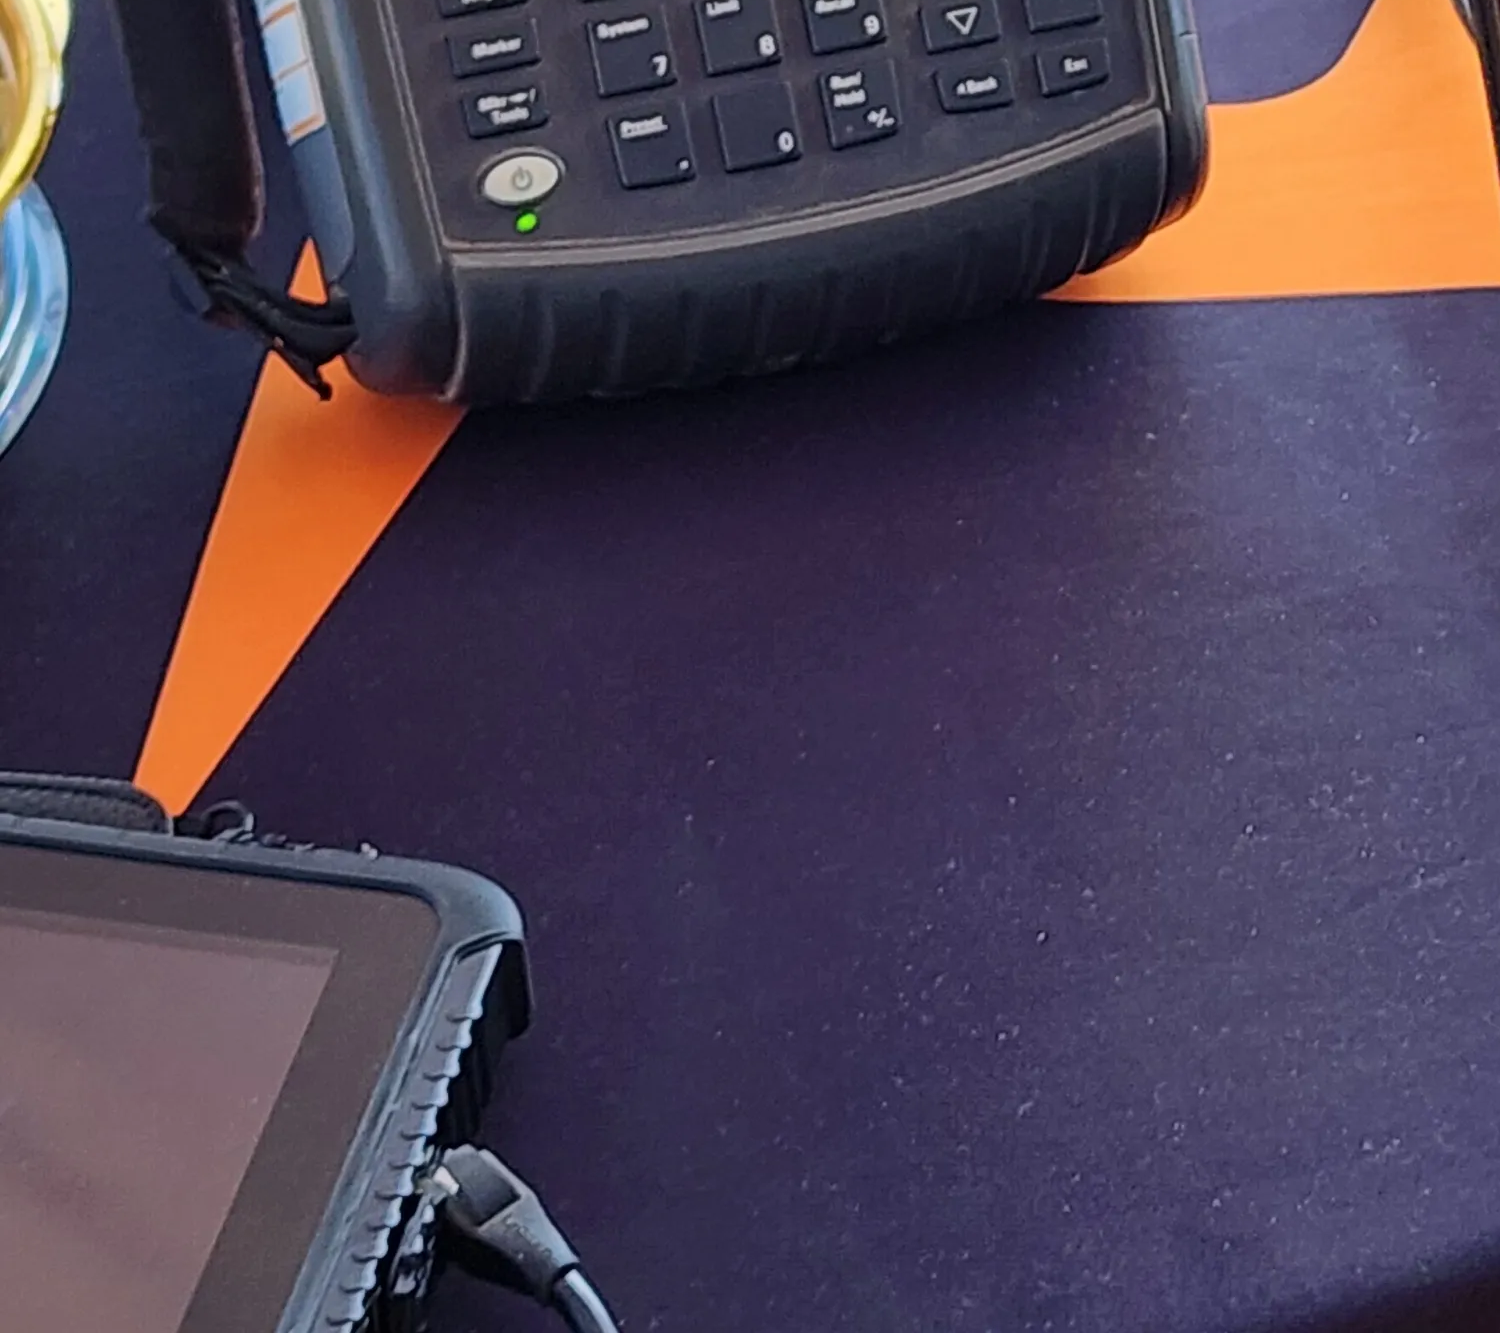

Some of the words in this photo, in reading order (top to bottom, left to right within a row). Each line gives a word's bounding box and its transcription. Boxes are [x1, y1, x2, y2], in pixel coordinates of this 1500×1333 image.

[863, 14, 881, 36] 9
[758, 34, 777, 57] 8
[652, 54, 668, 77] 7
[777, 130, 795, 154] 0
